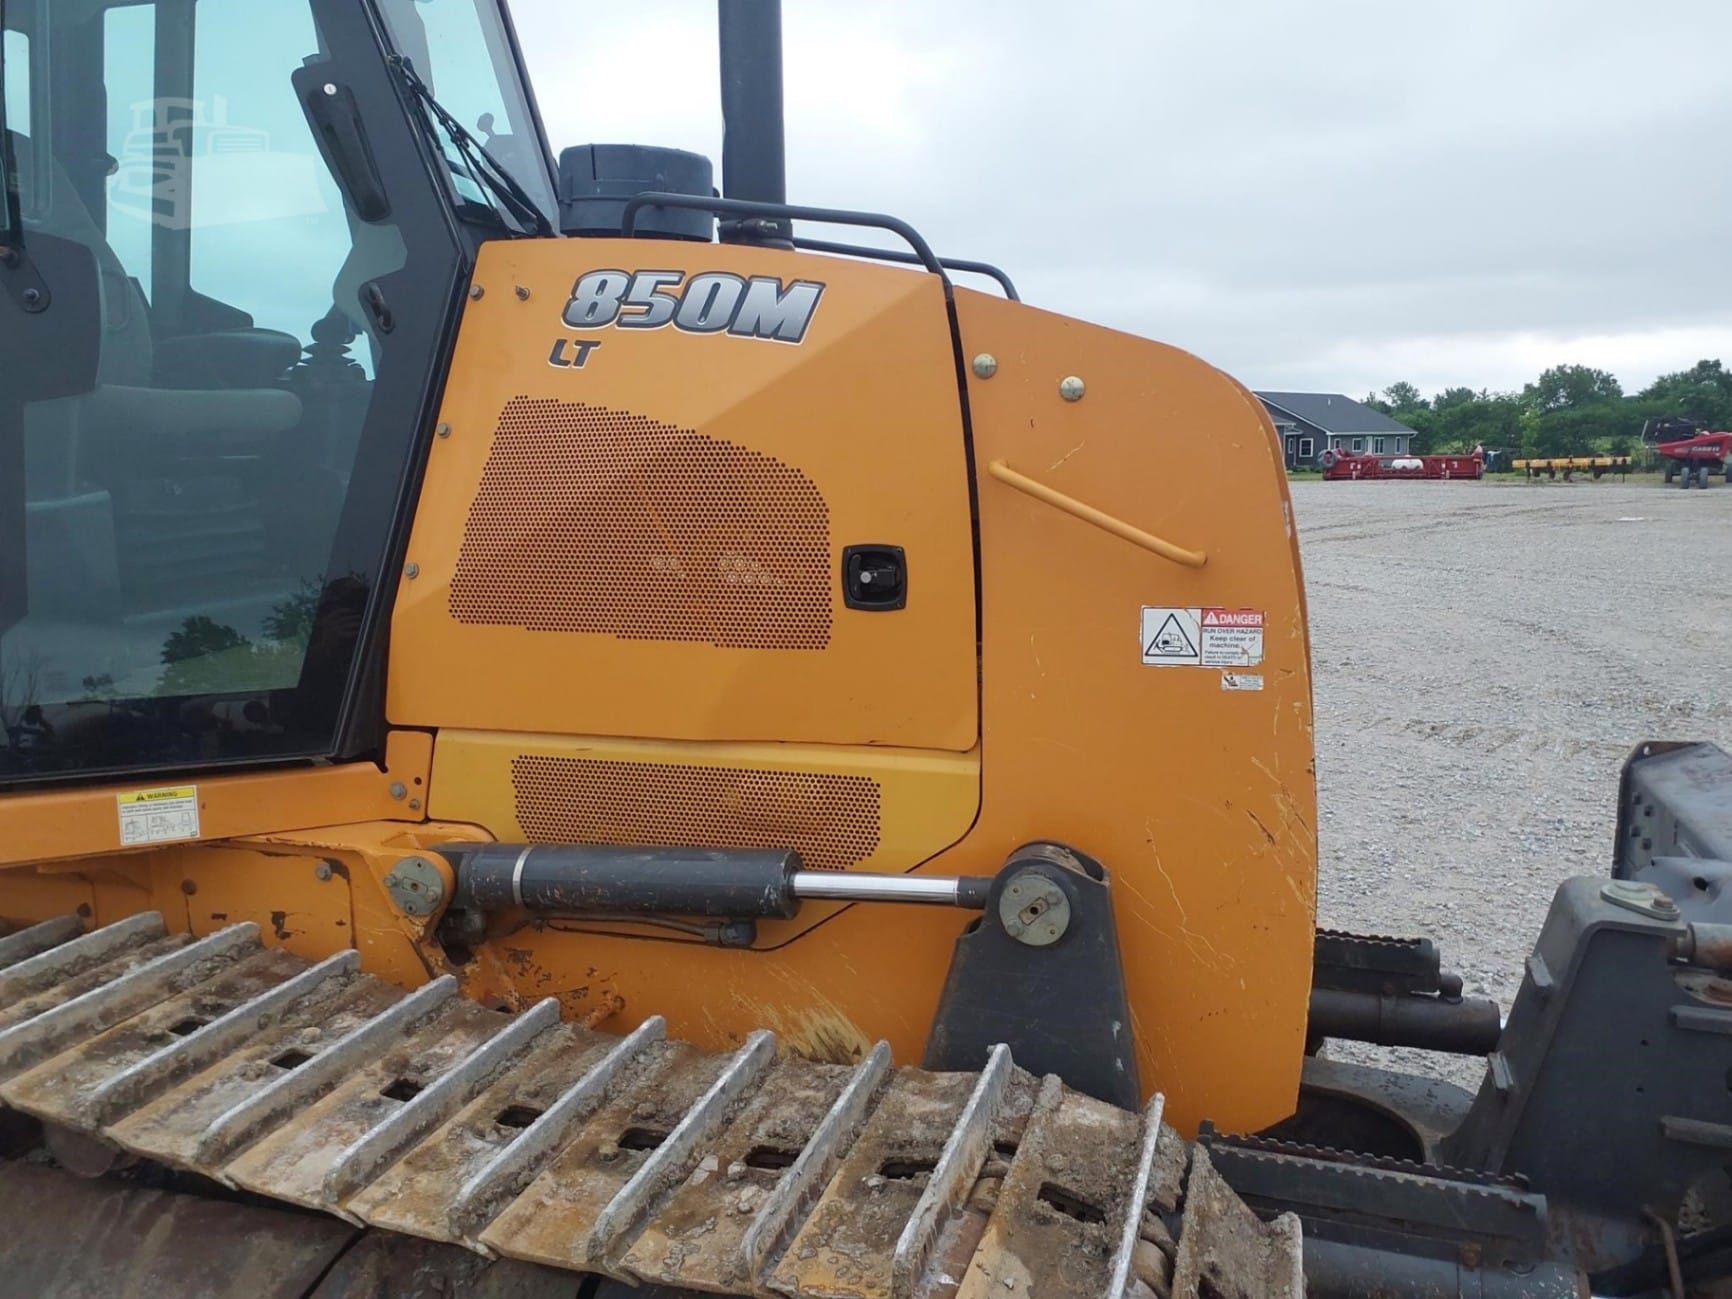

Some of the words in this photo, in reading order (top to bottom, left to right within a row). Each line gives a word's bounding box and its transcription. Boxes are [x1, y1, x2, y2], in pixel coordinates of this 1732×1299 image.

[561, 268, 827, 345] 850M
[548, 338, 602, 369] LT
[1219, 613, 1263, 625] DANGER
[146, 791, 178, 800] WARNING
